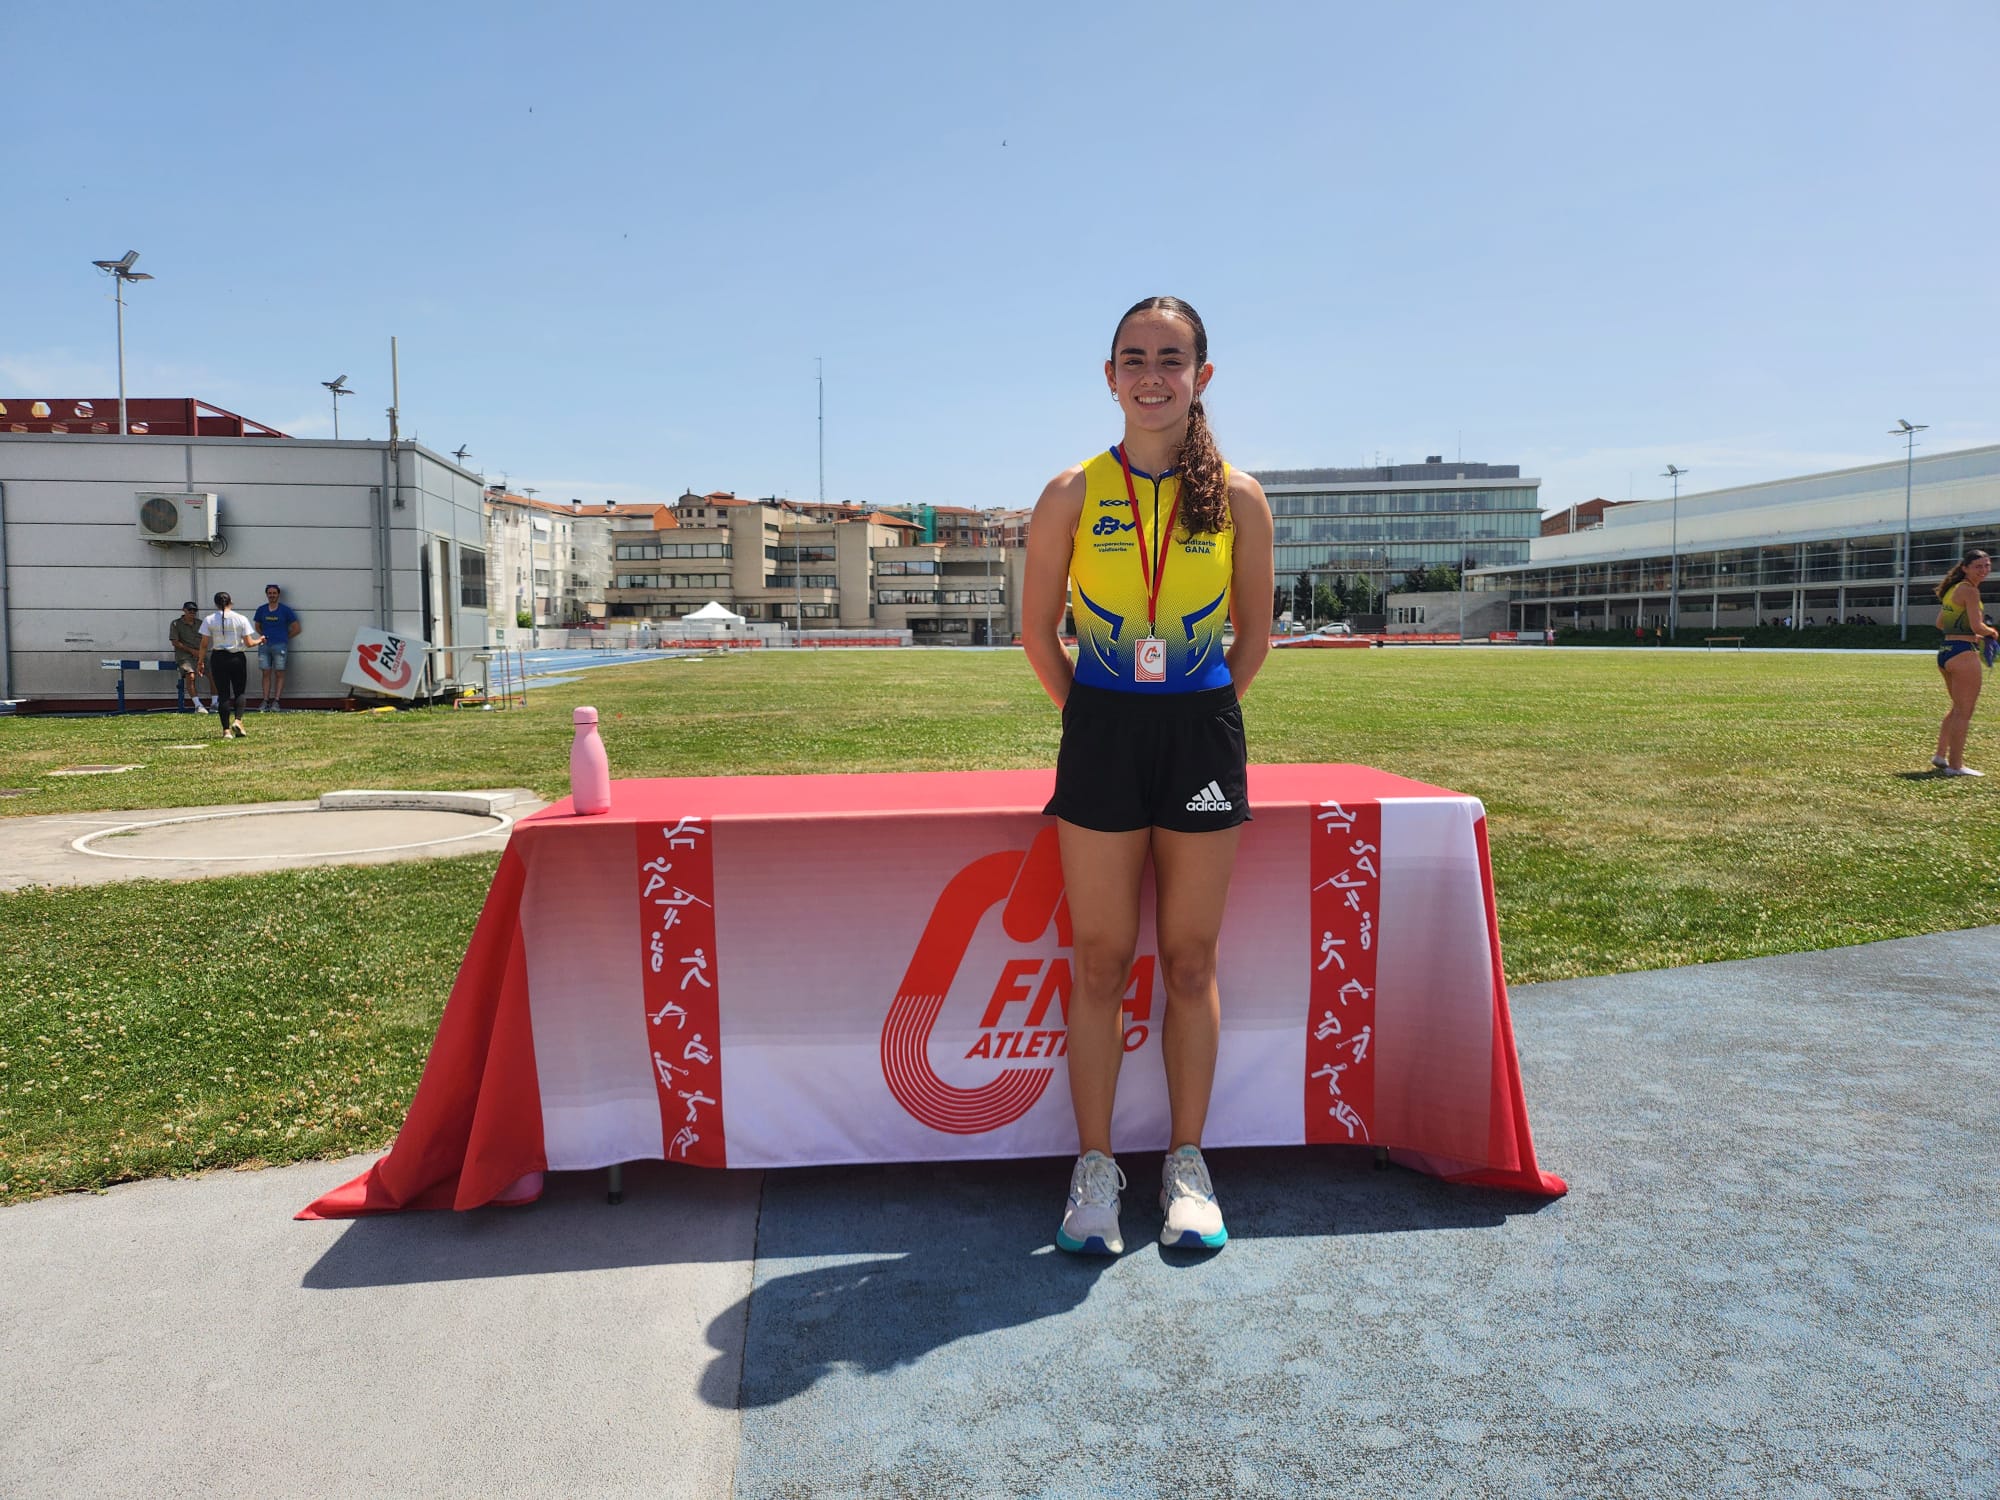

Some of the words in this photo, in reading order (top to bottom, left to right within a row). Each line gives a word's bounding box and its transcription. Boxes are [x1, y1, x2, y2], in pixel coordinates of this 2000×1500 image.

[380, 636, 401, 671] FNA
[1186, 800, 1232, 811] adidas
[964, 1024, 1149, 1059] ATLETIO
